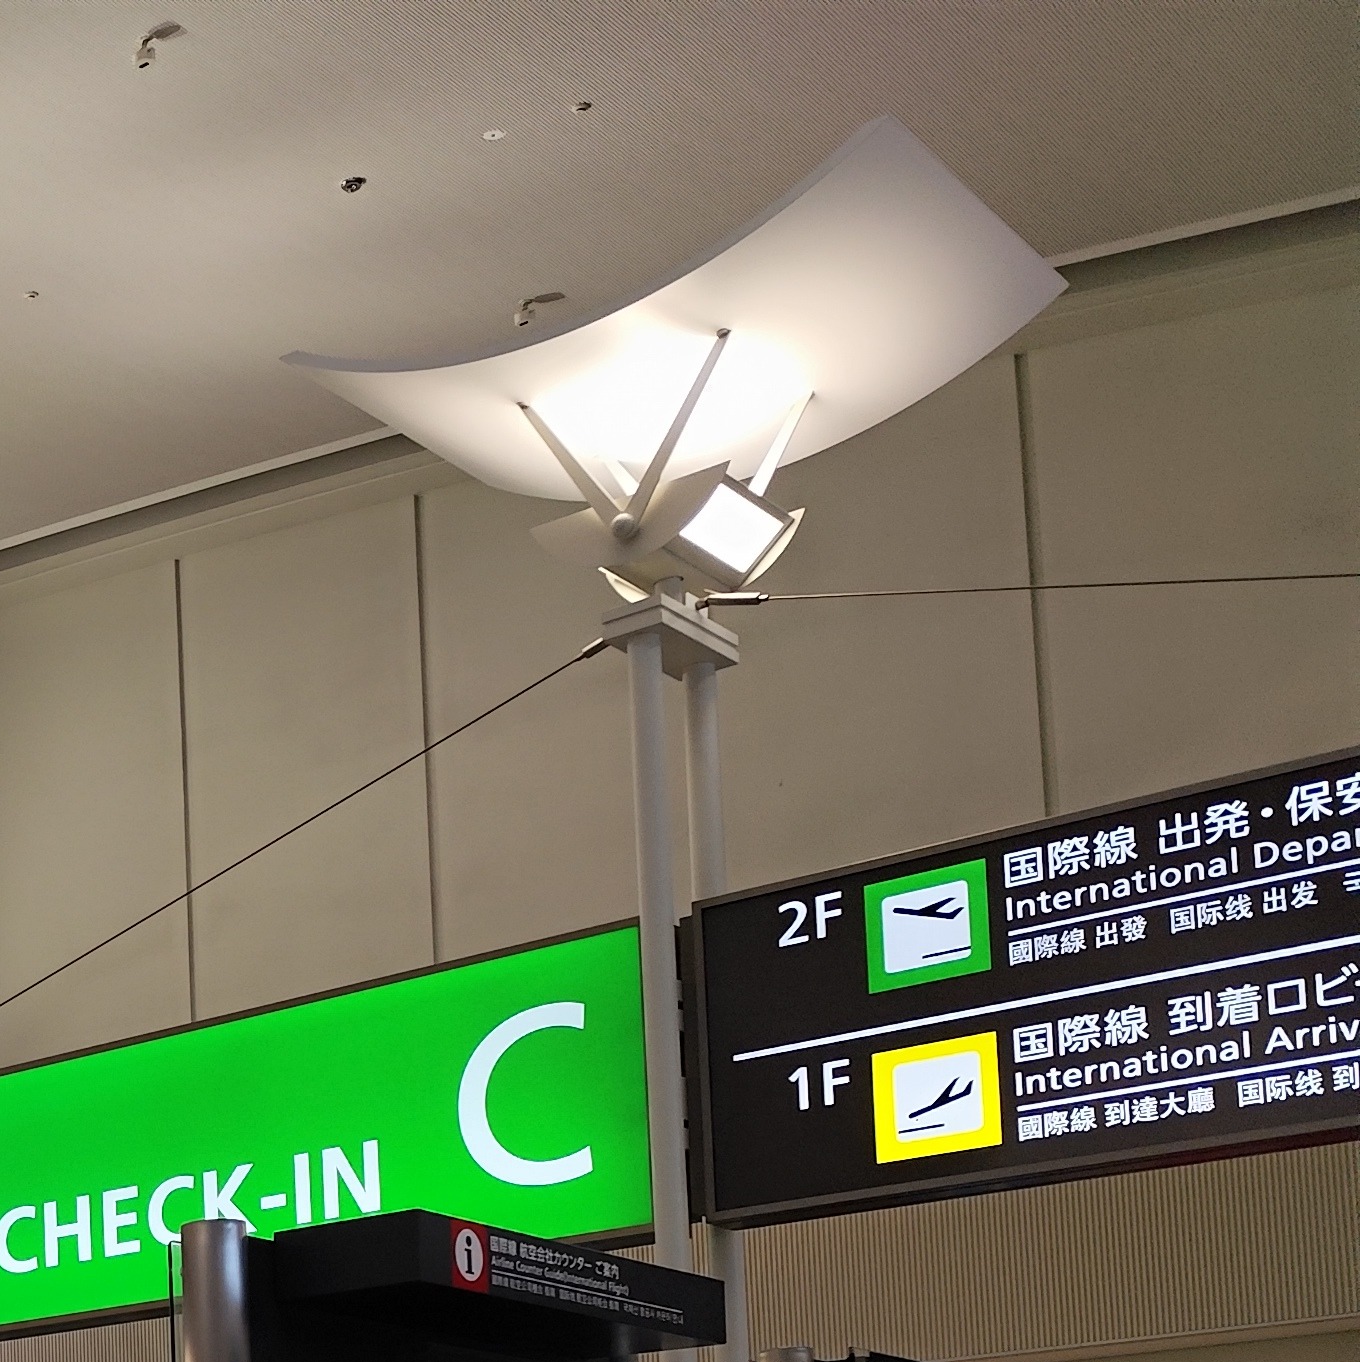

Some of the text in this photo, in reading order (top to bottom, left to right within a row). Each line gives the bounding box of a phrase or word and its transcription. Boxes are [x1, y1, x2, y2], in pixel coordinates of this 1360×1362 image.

[1003, 825, 1139, 889] 国際線
[1005, 846, 1239, 922] International
[778, 891, 843, 948] 2F
[1008, 928, 1087, 966] 國際線
[1094, 915, 1148, 949] 出發
[1169, 893, 1254, 935] 国际线
[1263, 880, 1319, 914] 出发
[1012, 962, 1360, 1063] 国際線 到着ロビ
[456, 1001, 595, 1187] C
[787, 1059, 851, 1111] 1F
[1014, 1030, 1251, 1096] International
[1017, 1106, 1098, 1142] 國際線
[1104, 1087, 1216, 1129] 到達大廳
[1237, 1068, 1325, 1108] 国际线
